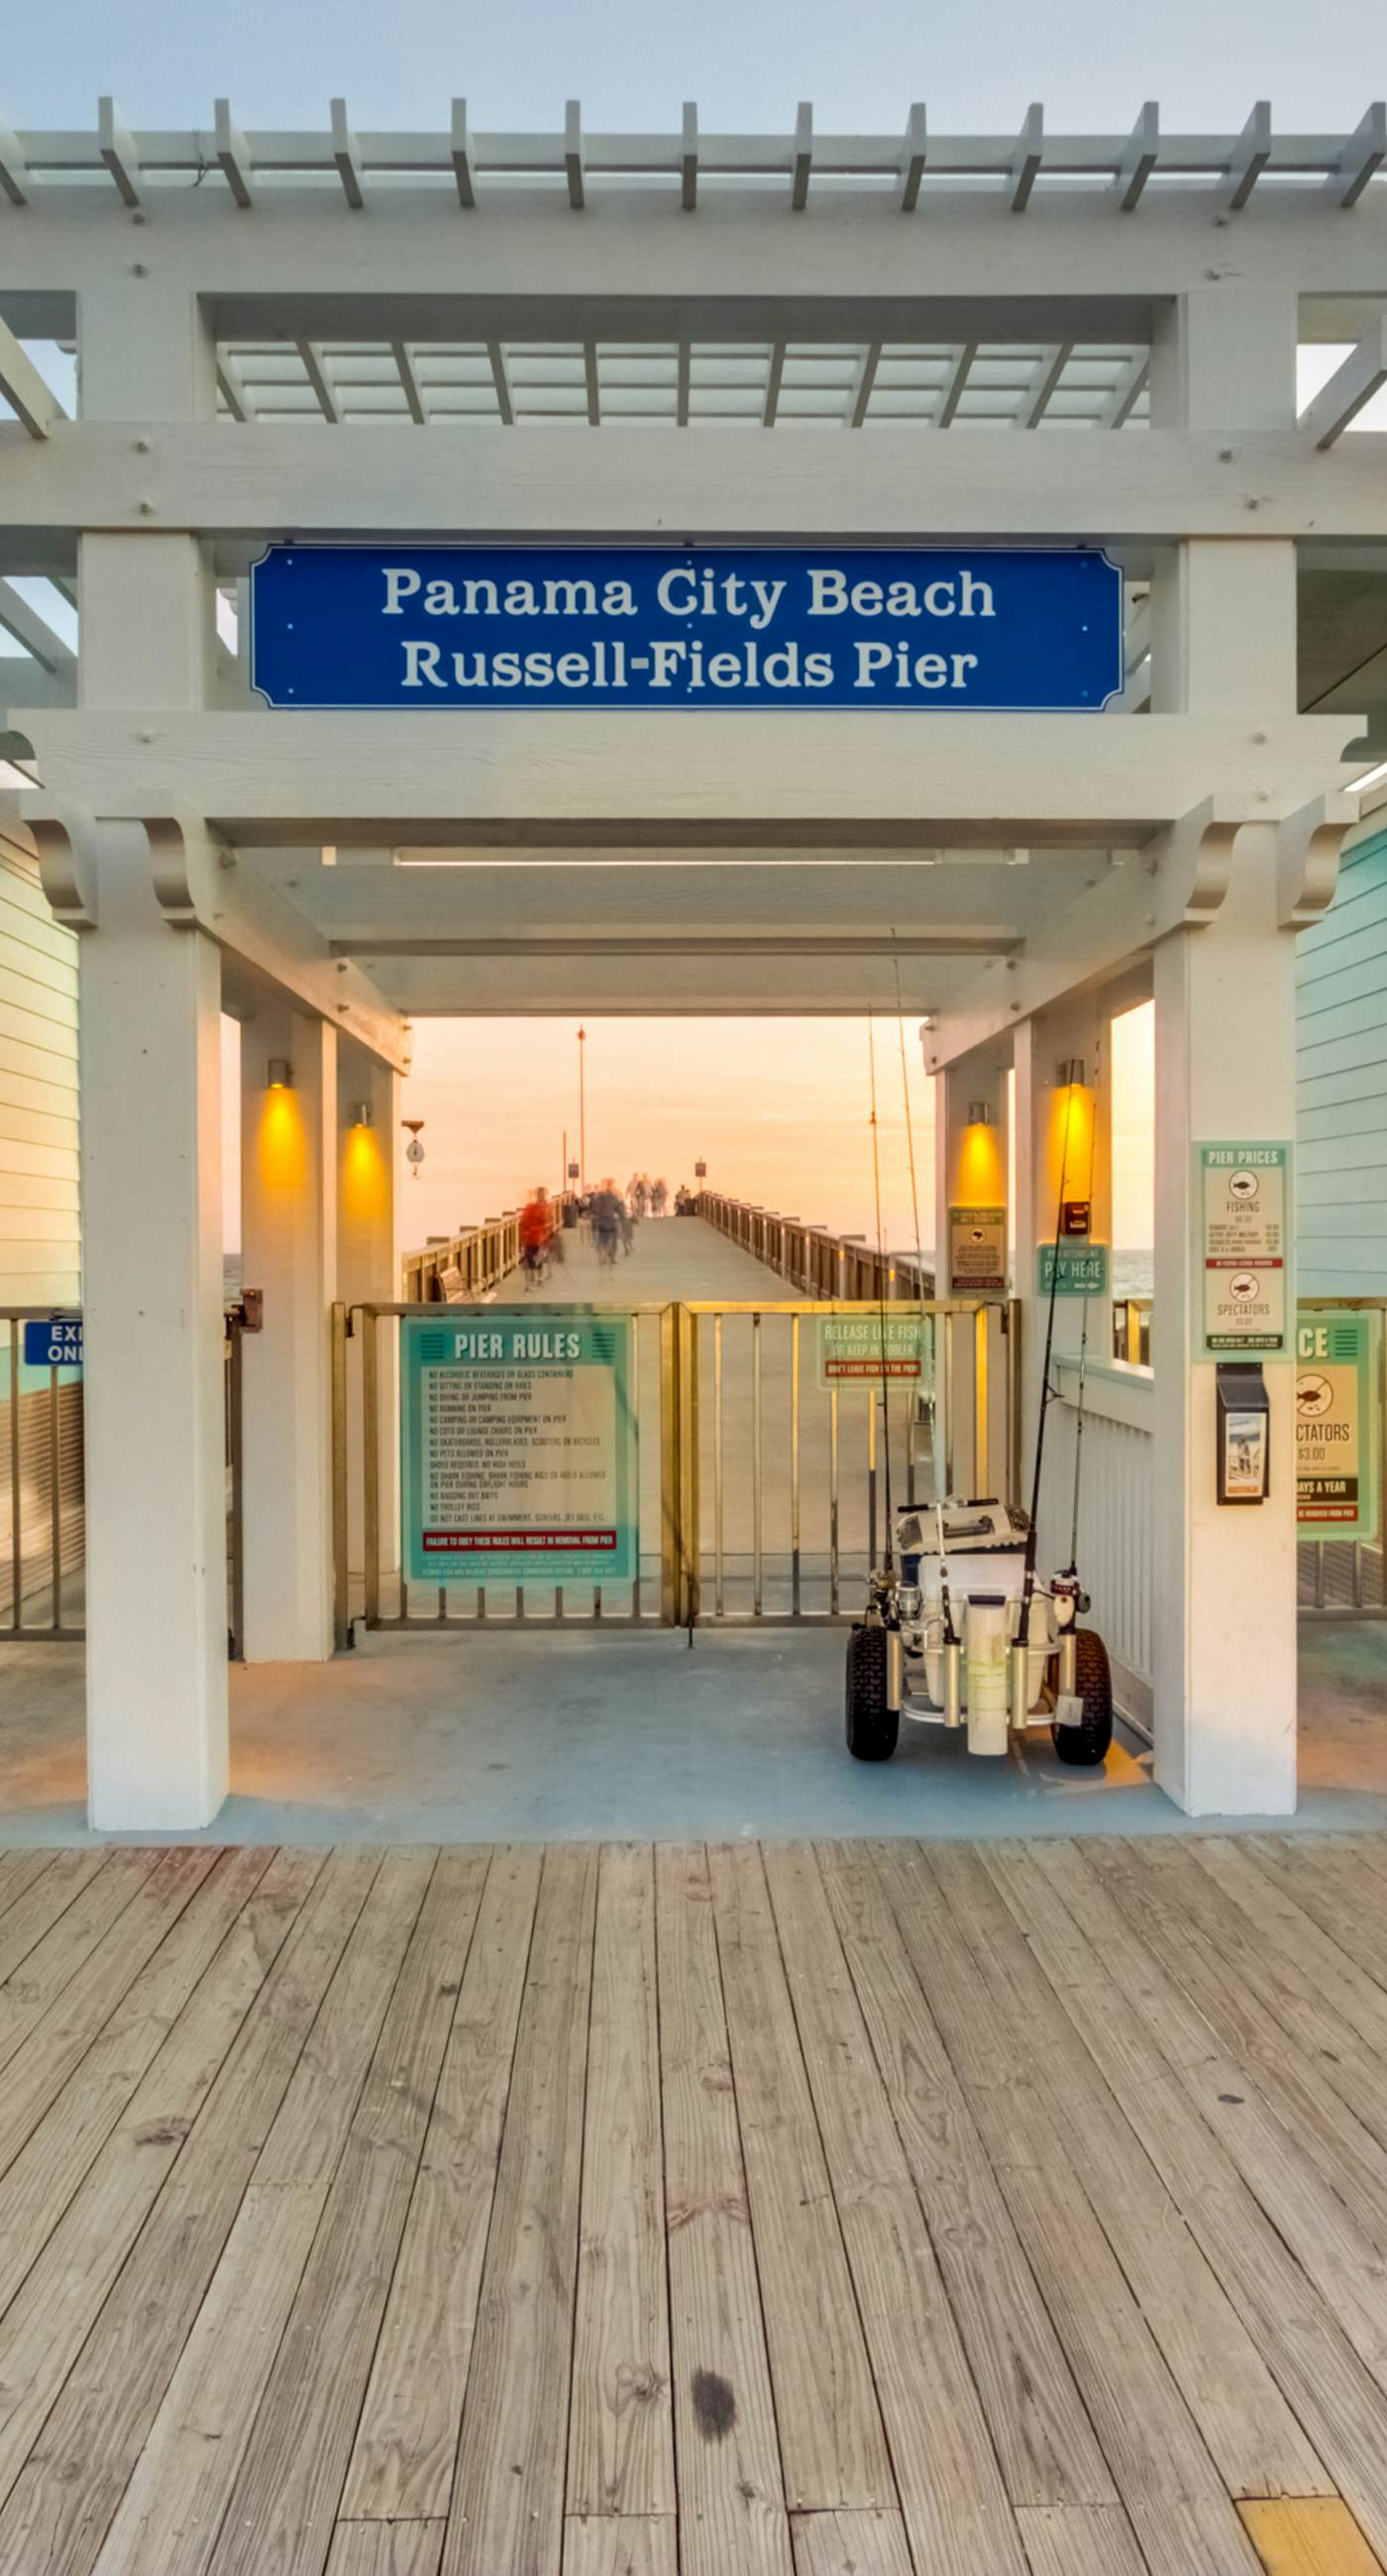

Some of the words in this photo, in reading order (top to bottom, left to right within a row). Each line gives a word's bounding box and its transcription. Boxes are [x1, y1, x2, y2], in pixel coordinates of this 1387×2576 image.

[381, 568, 638, 616] Panama
[657, 567, 787, 630] City
[806, 568, 997, 616] Beach
[400, 641, 834, 688] Russell-Fields
[854, 641, 979, 688] Pier
[1209, 1150, 1234, 1165] PIER
[1237, 1150, 1279, 1165] PRICES
[1227, 1201, 1260, 1213] FISHING
[1071, 1261, 1101, 1278] HERE
[1217, 1303, 1270, 1316] SPECTATORS
[52, 1325, 83, 1341] EXI
[824, 1325, 869, 1340] RELEASE
[899, 1325, 920, 1340] FISH
[455, 1333, 503, 1359] PIER
[512, 1333, 581, 1359] RULES
[1298, 1328, 1328, 1357] CE
[48, 1345, 83, 1361] ONL
[1296, 1424, 1349, 1442] CTATORS
[1298, 1447, 1326, 1460] $3.00
[1297, 1481, 1315, 1494] AYS
[1316, 1481, 1324, 1494] A
[1325, 1481, 1346, 1494] YEAR
